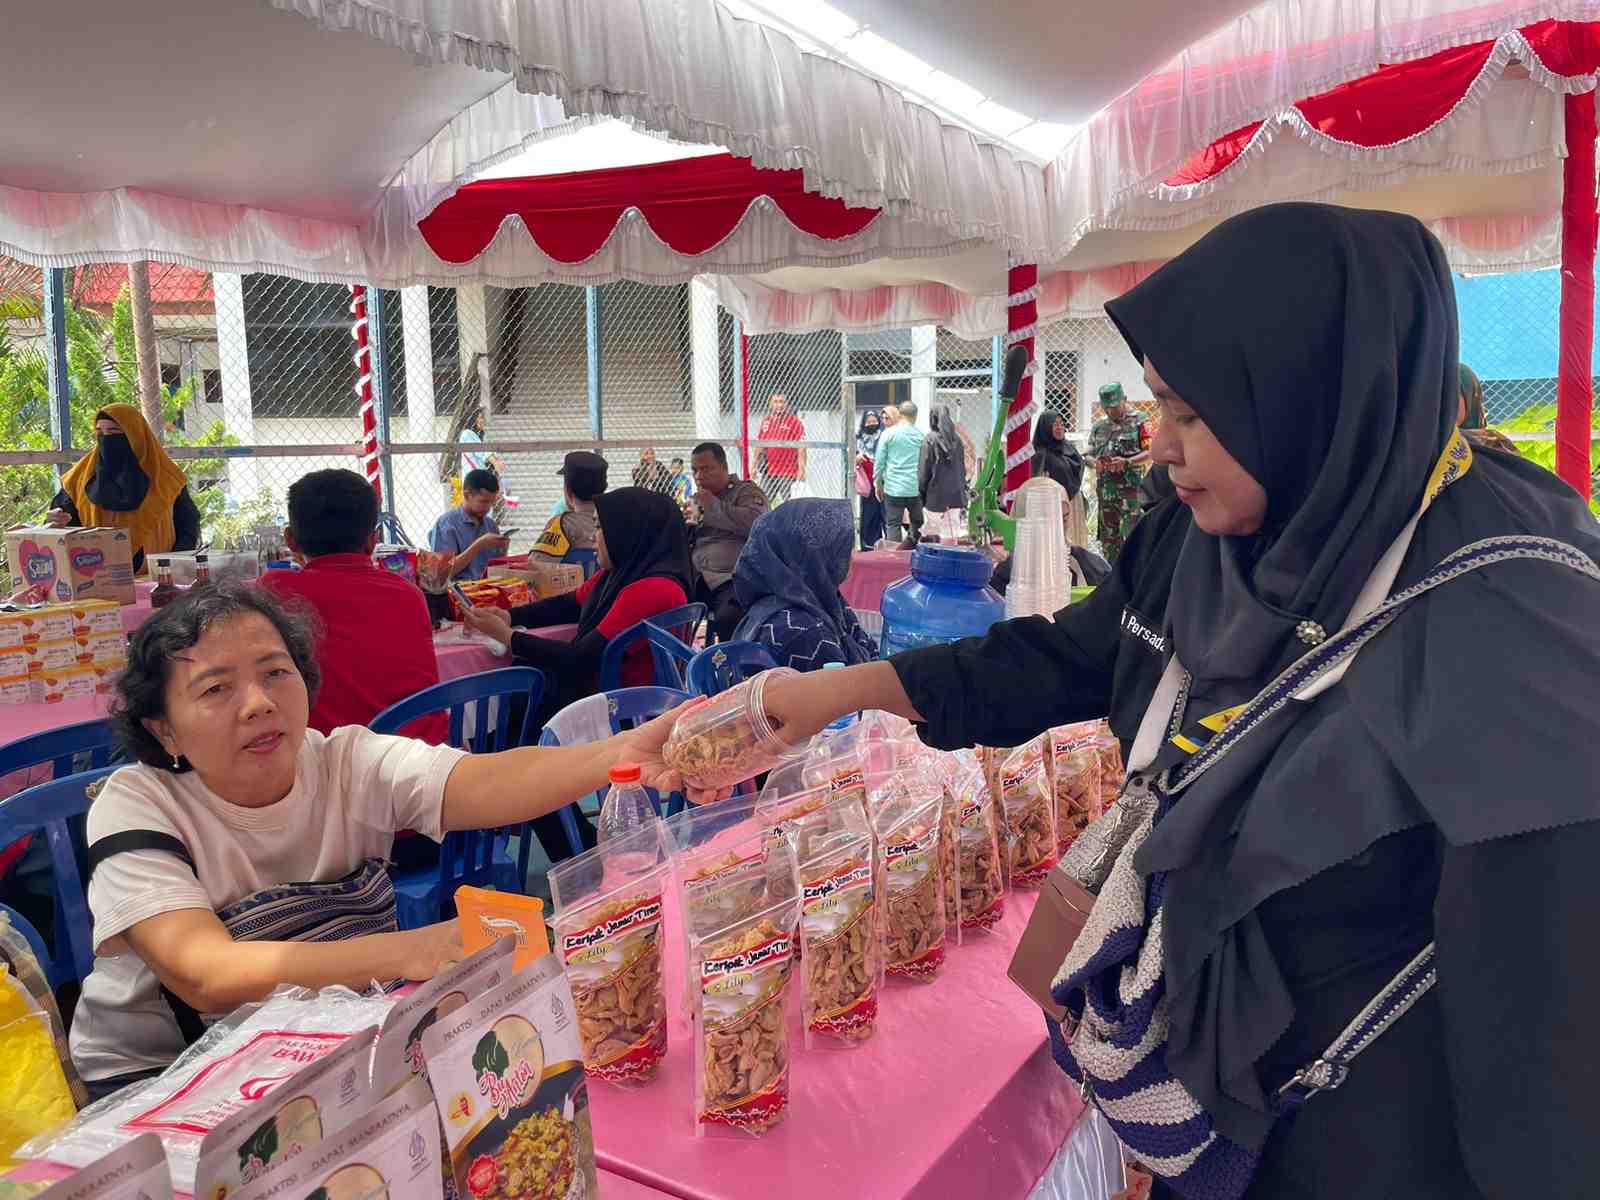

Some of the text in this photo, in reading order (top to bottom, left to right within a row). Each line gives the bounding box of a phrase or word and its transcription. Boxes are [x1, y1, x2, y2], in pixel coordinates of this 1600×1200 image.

[565, 927, 605, 948] Keripik
[606, 914, 634, 934] Jamur
[703, 955, 745, 976] Keripik
